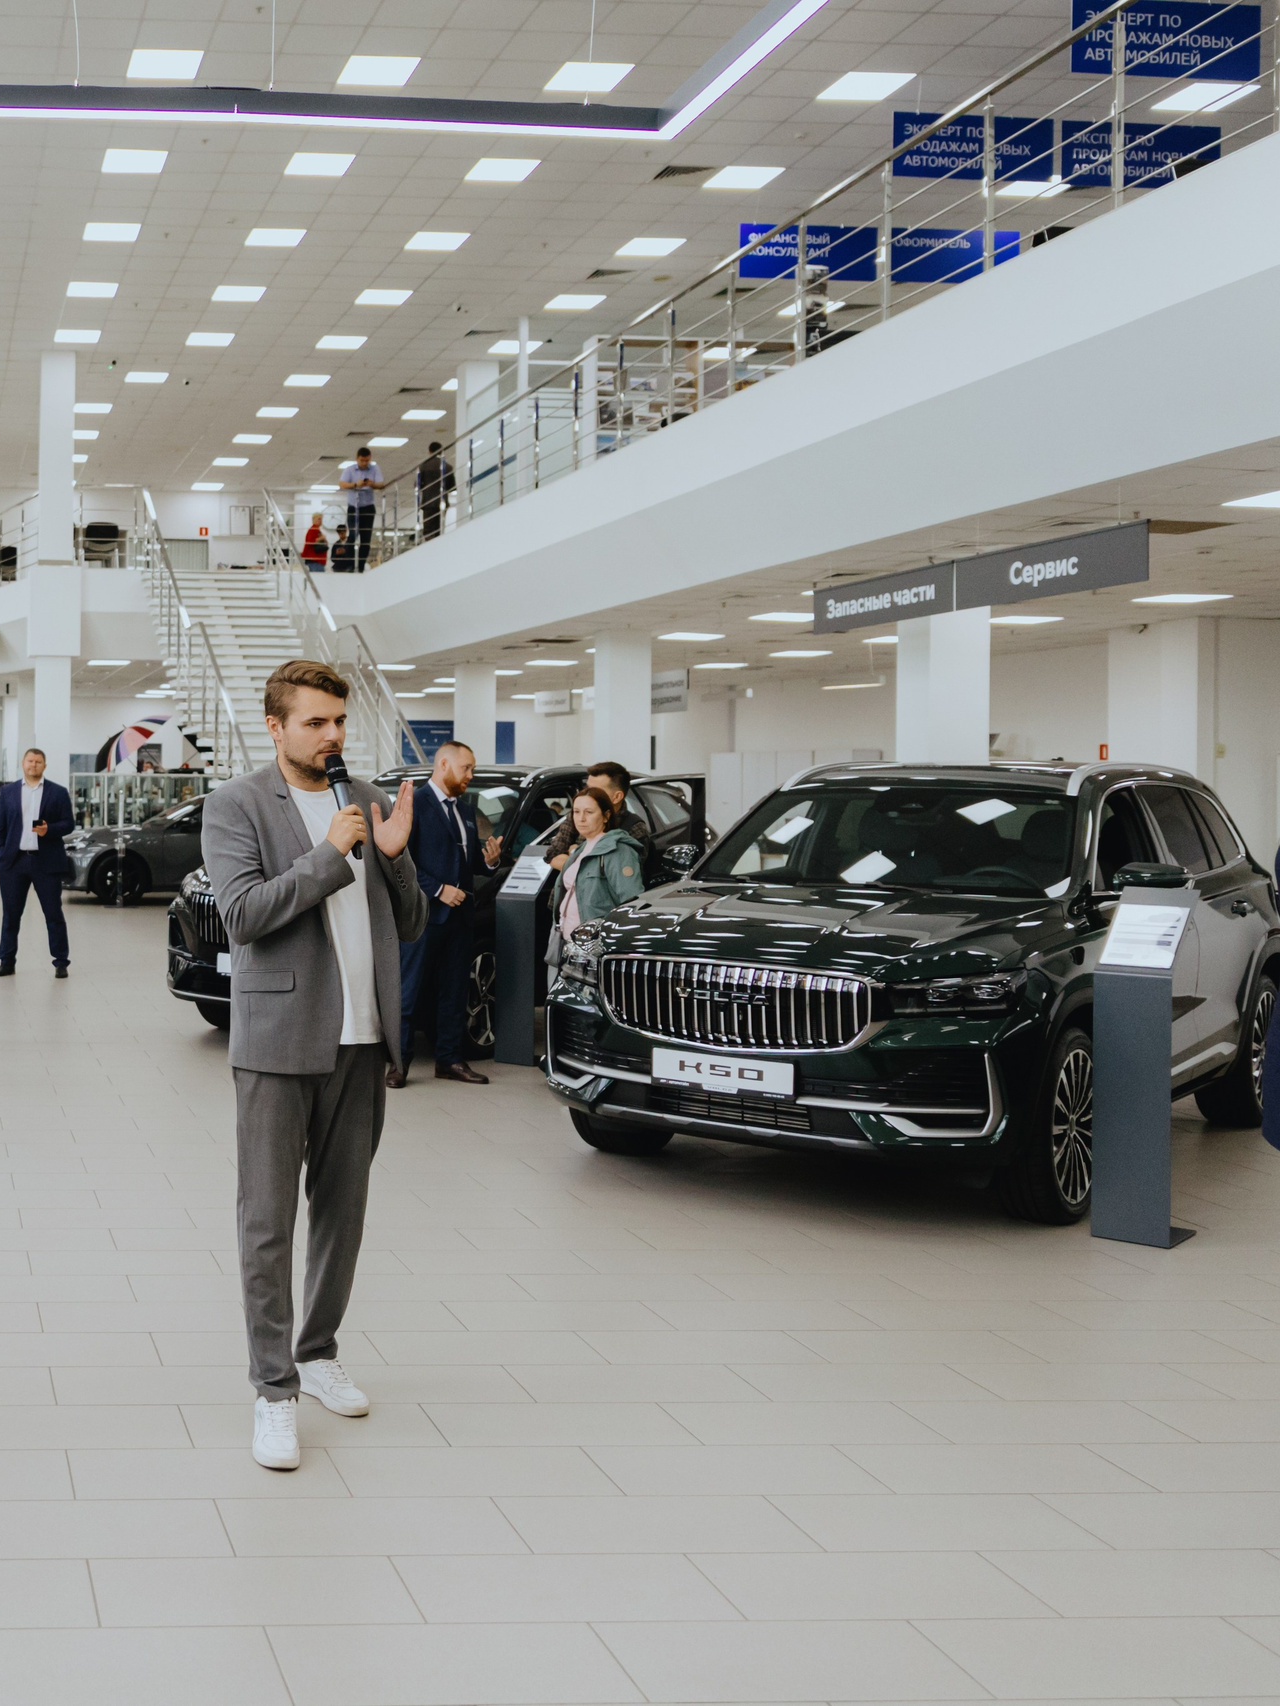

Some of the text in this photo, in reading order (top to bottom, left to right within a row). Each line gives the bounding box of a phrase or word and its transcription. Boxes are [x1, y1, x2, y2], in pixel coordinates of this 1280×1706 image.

[1159, 14, 1182, 28] ПО
[1085, 29, 1235, 49] ПРОАЖАМ НОВЫХ
[1084, 47, 1201, 66] АВТМОБИЛЕЙ
[904, 123, 963, 137] ЭКЕРТ
[1073, 132, 1132, 145] ЭКСПТ
[904, 139, 1031, 155] ОДАЖАМ ОВЫХ
[1073, 147, 1148, 162] ПРОДАМ
[903, 154, 1002, 170] АВТОМОБИЛЙ
[1073, 163, 1171, 178] АВТОБИЛЕЙ
[748, 232, 831, 244] ФАНСВЫЙ
[749, 246, 831, 257] ОНСУЛАНТ
[1009, 556, 1079, 587] Сервис
[826, 583, 936, 620] Запасные части
[675, 987, 770, 1006] VOLGA
